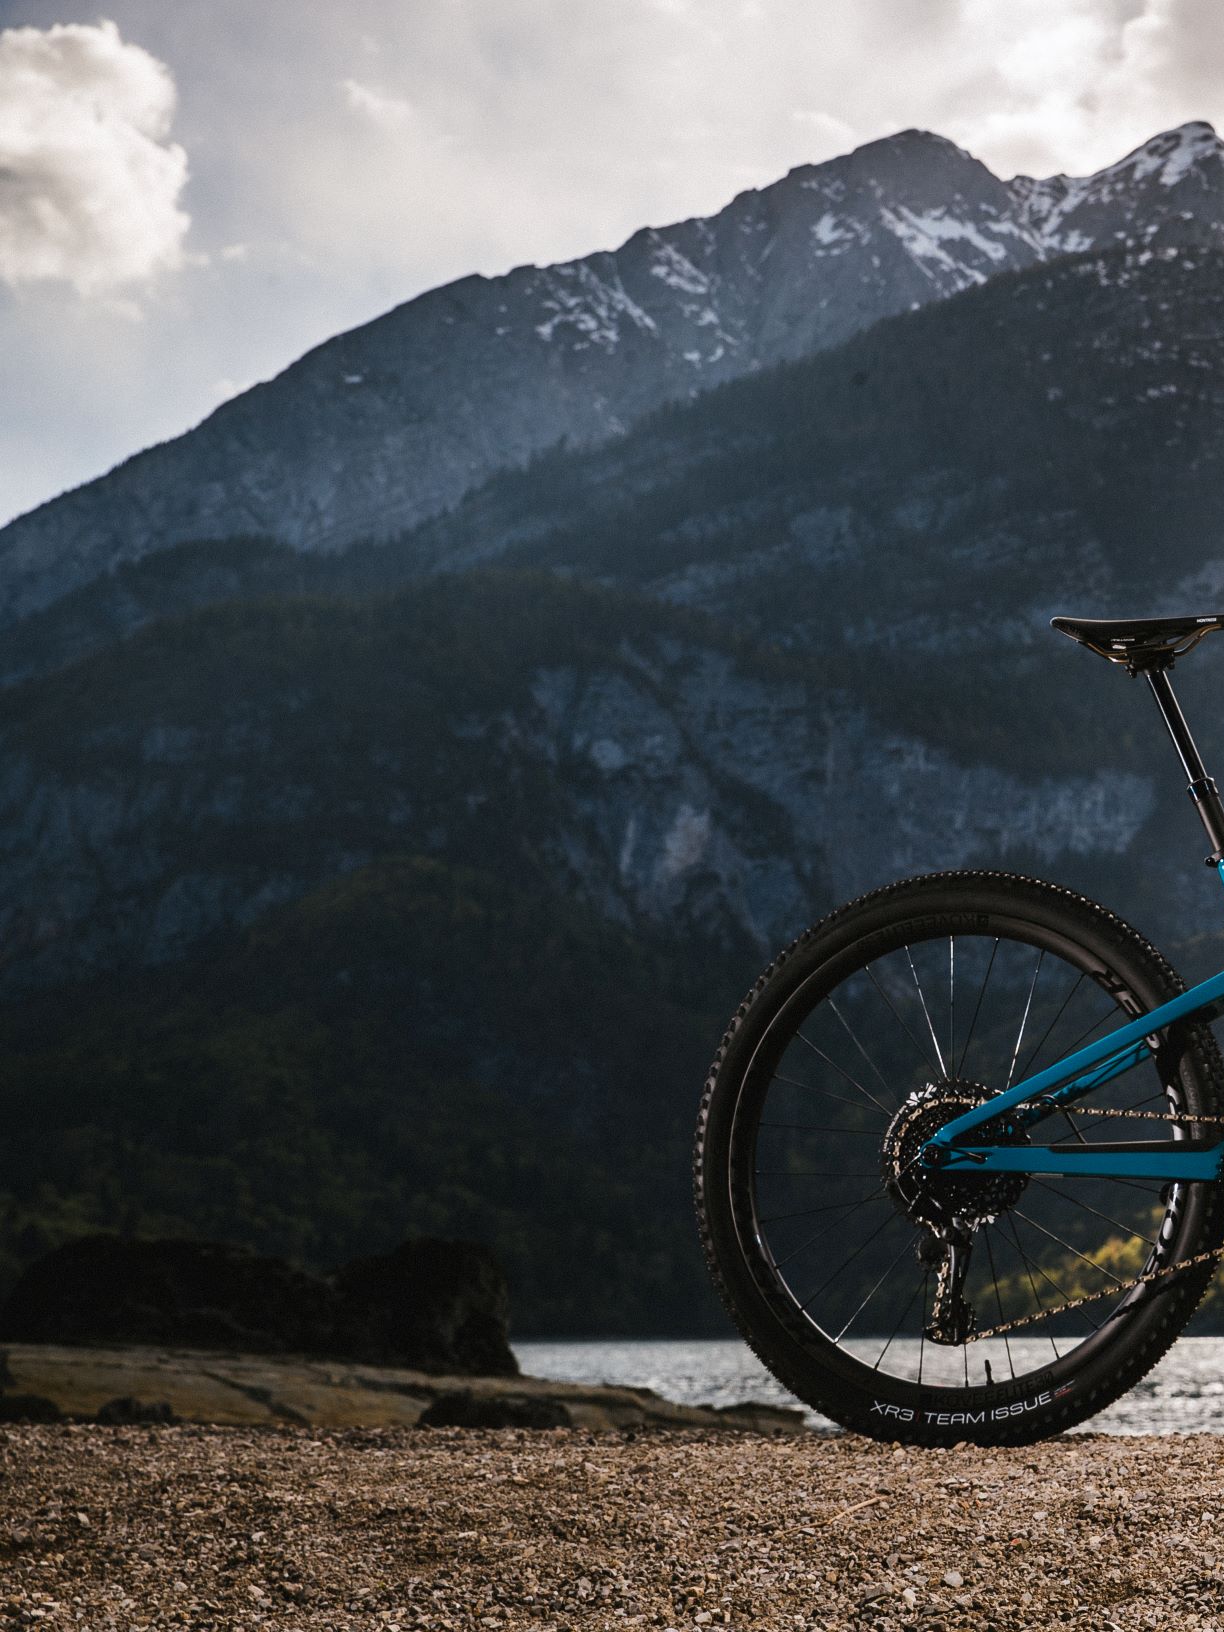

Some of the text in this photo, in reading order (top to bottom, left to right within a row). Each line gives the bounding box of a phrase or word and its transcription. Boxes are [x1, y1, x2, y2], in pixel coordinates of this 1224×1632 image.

[869, 1391, 1052, 1425] XR3 TEAM ISSUE
